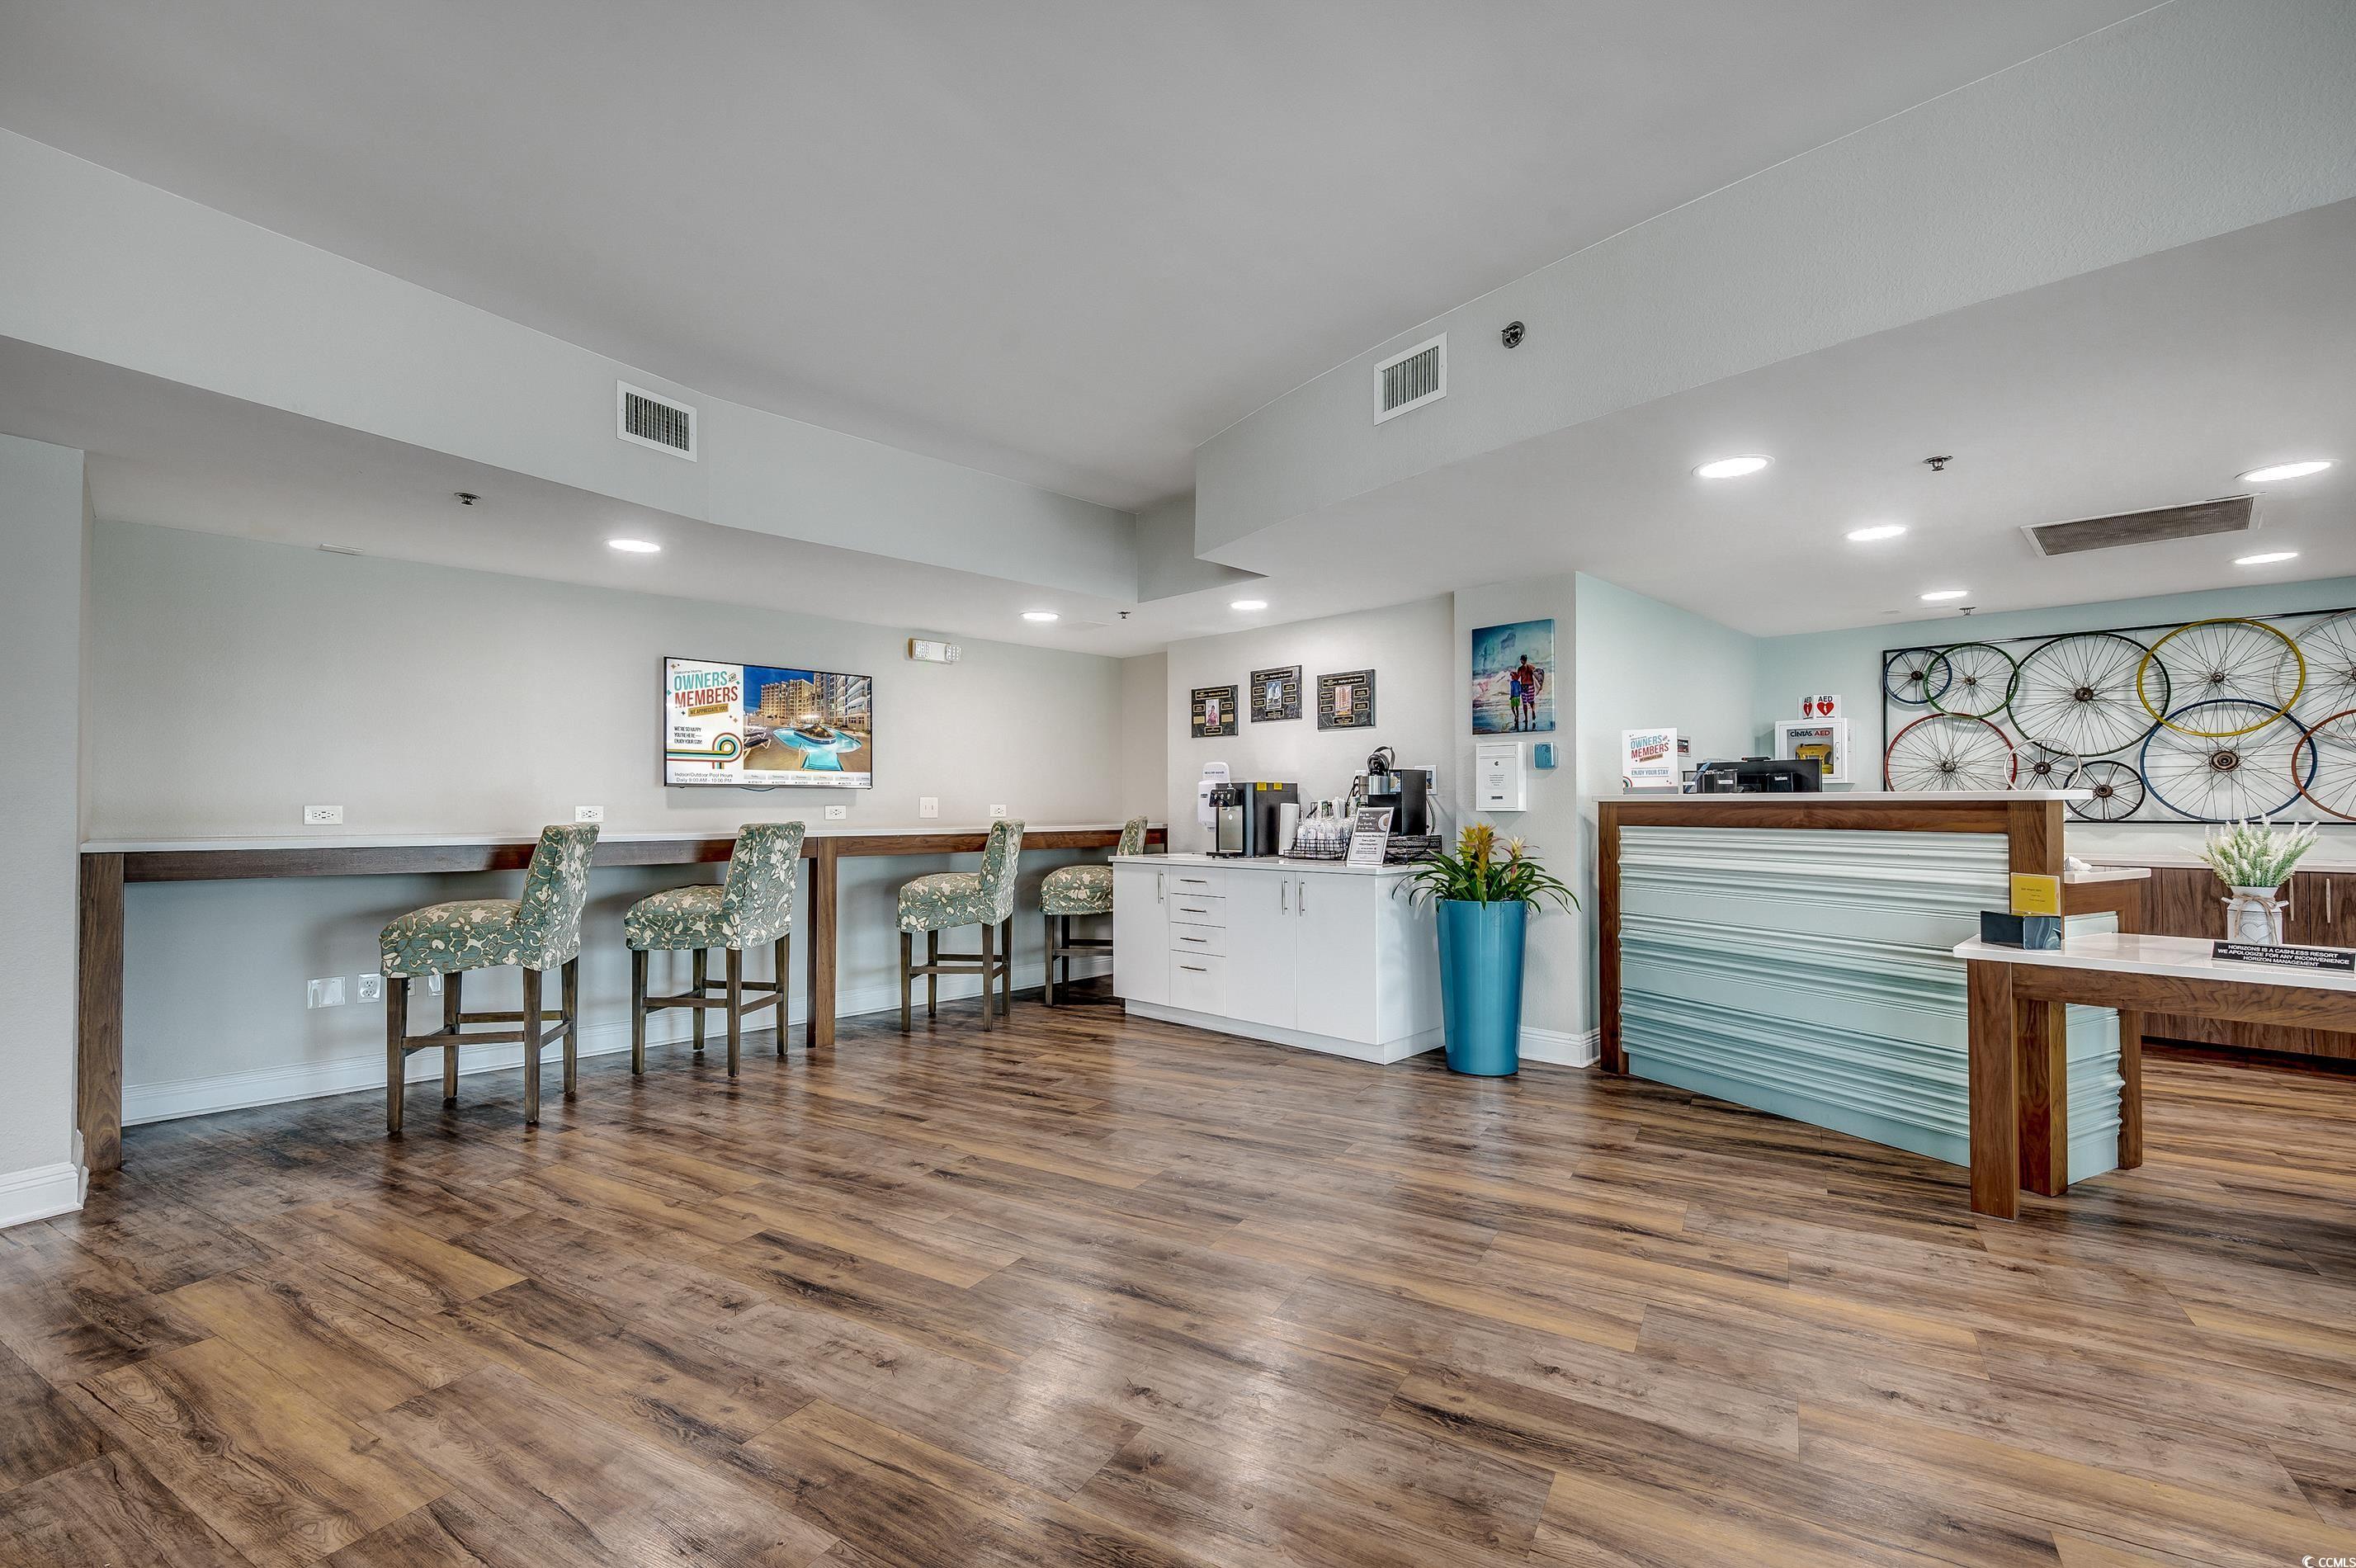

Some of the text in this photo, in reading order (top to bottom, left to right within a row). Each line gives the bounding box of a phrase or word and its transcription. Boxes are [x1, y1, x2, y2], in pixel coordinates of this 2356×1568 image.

[674, 671, 737, 691] OWNERS AND
[675, 686, 738, 708] MEMBERS
[1631, 735, 1662, 749] OWNERS
[1631, 742, 1669, 758] MEMBERS
[2294, 955, 2350, 964] INCONVENIENCE
